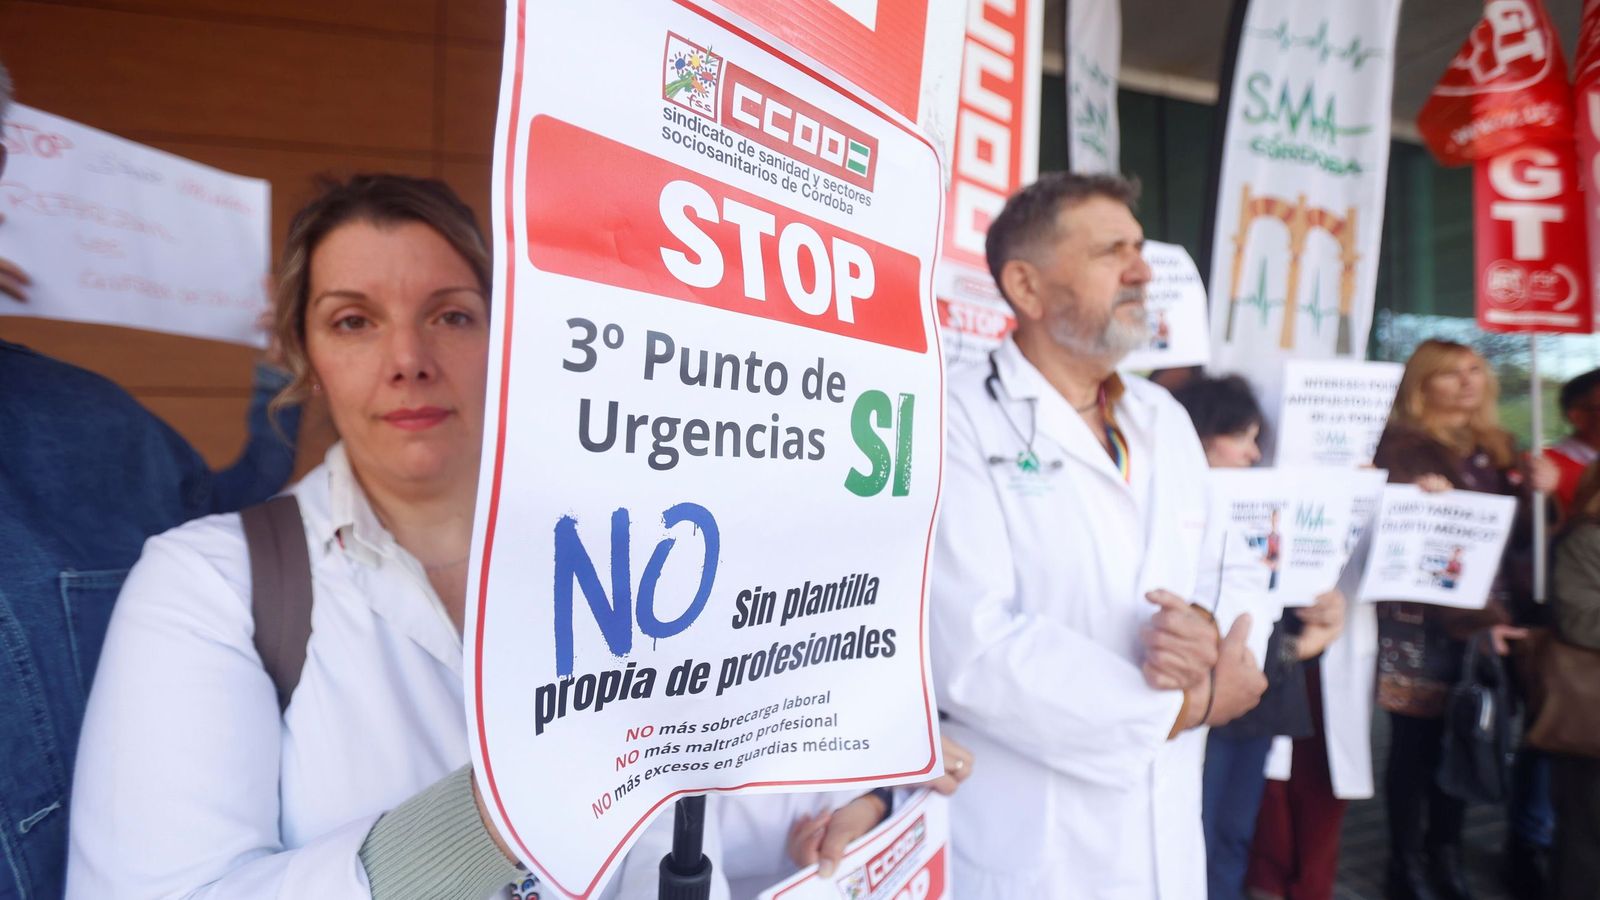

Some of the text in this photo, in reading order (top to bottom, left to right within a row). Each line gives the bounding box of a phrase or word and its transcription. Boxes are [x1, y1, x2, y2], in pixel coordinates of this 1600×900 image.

[731, 81, 846, 168] CCOO
[1243, 69, 1374, 146] SMA
[661, 126, 854, 215] sociosanitarios de Córdoba
[662, 106, 872, 207] sindicato de sanidad y sectores
[659, 179, 876, 324] STOP
[562, 317, 847, 404] 3º Punto de
[947, 303, 1007, 338] STOP
[578, 397, 826, 471] Urgencias
[844, 389, 916, 498] SI
[553, 501, 721, 678] NO
[731, 573, 880, 630] Sin plantilla
[534, 624, 897, 736] propia de profesionales
[625, 691, 831, 743] NO más sobrecarga laboral
[591, 735, 870, 820] NO más excesos en guardias médicas
[615, 713, 838, 771] NO más maltrato profesional
